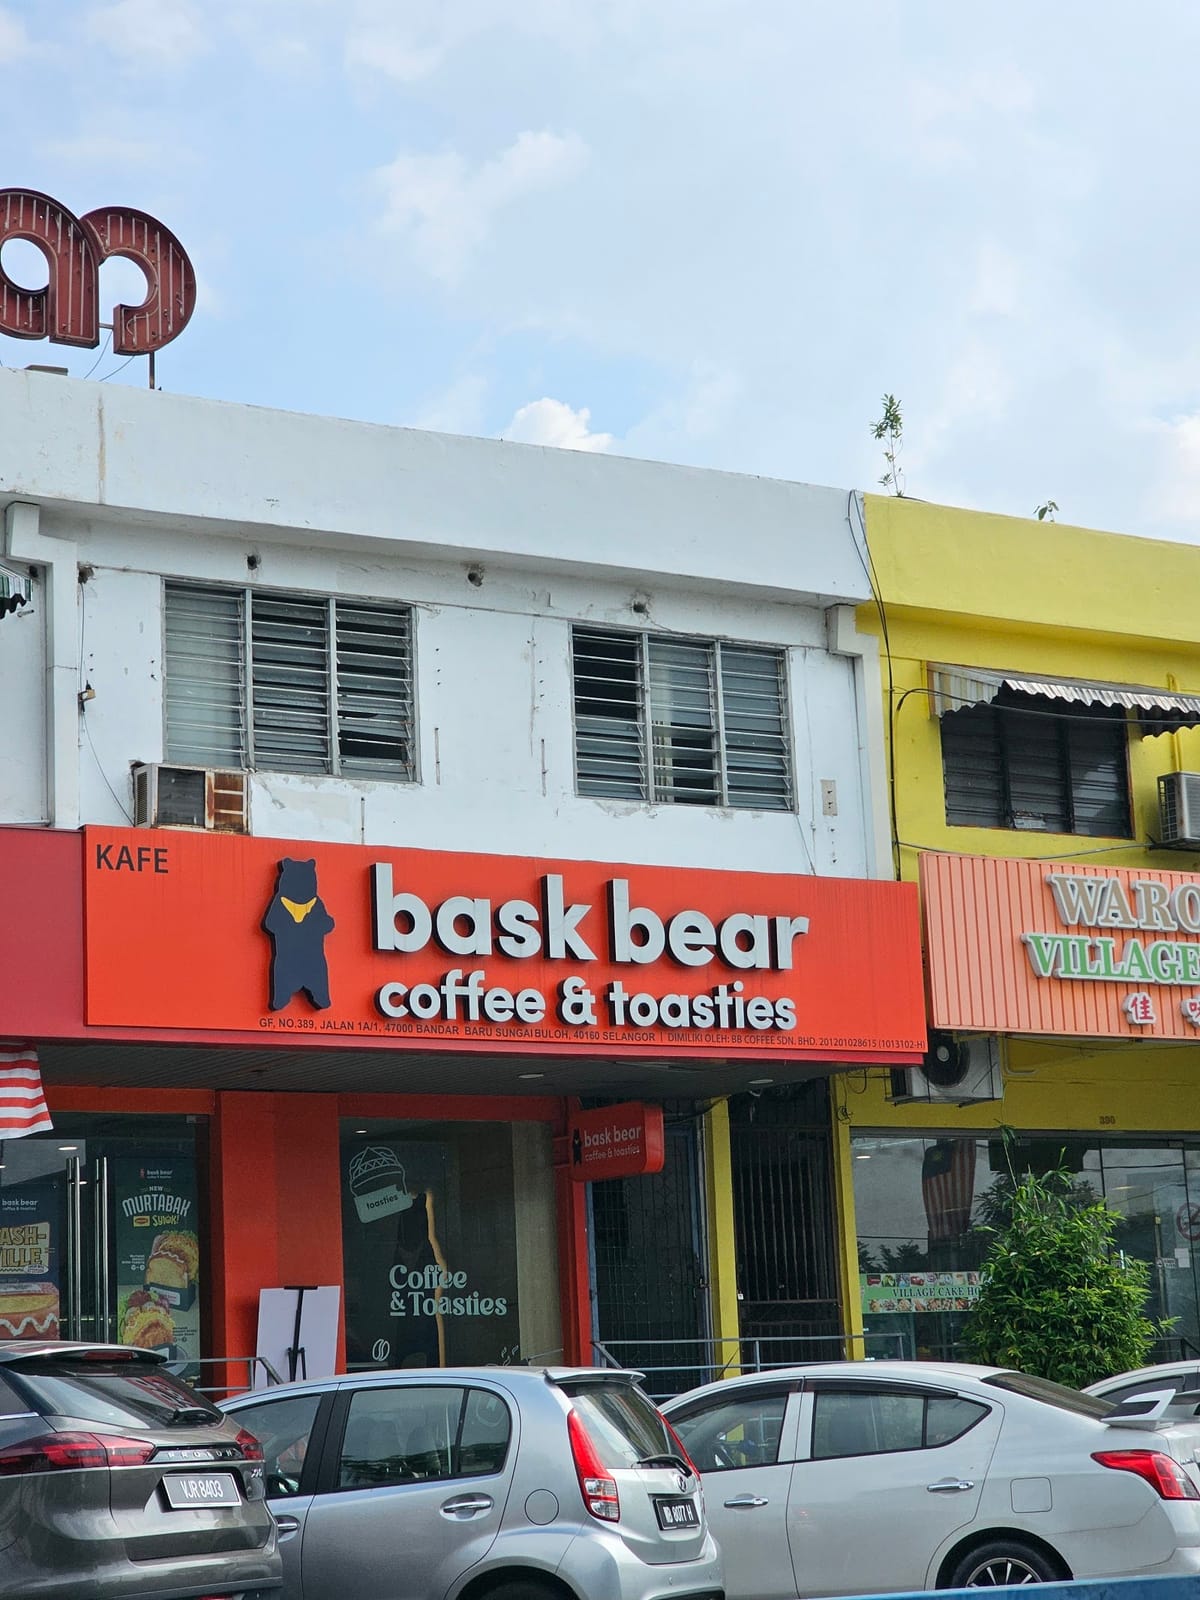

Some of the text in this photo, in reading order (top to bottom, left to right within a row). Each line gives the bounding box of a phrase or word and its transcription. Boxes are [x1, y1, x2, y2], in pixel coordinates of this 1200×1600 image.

[95, 844, 169, 874] KAFE
[371, 862, 809, 970] bask bear
[1020, 933, 1200, 986] VILLAGE
[376, 970, 797, 1031] coffee & toasties
[258, 1017, 276, 1029] GF,
[278, 1018, 317, 1030] NO.389,
[320, 1021, 354, 1031] JALAN
[357, 1021, 382, 1032] 1A/1,
[384, 1023, 414, 1033] 47000
[416, 1024, 459, 1035] BANDAR
[464, 1026, 493, 1037] BARU
[495, 1027, 534, 1038] SUNGAI
[534, 1029, 571, 1040] BULOH,
[573, 1030, 600, 1041] 40160
[602, 1031, 656, 1042] SELANGOR
[667, 1033, 703, 1042] DIMILIKI
[704, 1034, 730, 1043] OLEH:
[731, 1035, 743, 1044] BB
[744, 1035, 776, 1045] COFFEE
[777, 1036, 796, 1045] SDN.
[798, 1037, 818, 1046] BHD.
[819, 1037, 877, 1048] 201201028615
[583, 1125, 642, 1148] bask bear
[585, 1144, 641, 1161] coffee & toasties
[2, 1198, 38, 1206] bask bear
[121, 1194, 192, 1217] MURTABAK
[365, 1192, 399, 1211] toasties
[0, 1247, 42, 1267] ILLE
[388, 1264, 468, 1289] Coffee
[389, 1291, 508, 1316] & Toasties
[893, 1286, 936, 1298] VILLAGE
[938, 1286, 964, 1298] CAKE
[180, 1480, 224, 1499] VJR 8403
